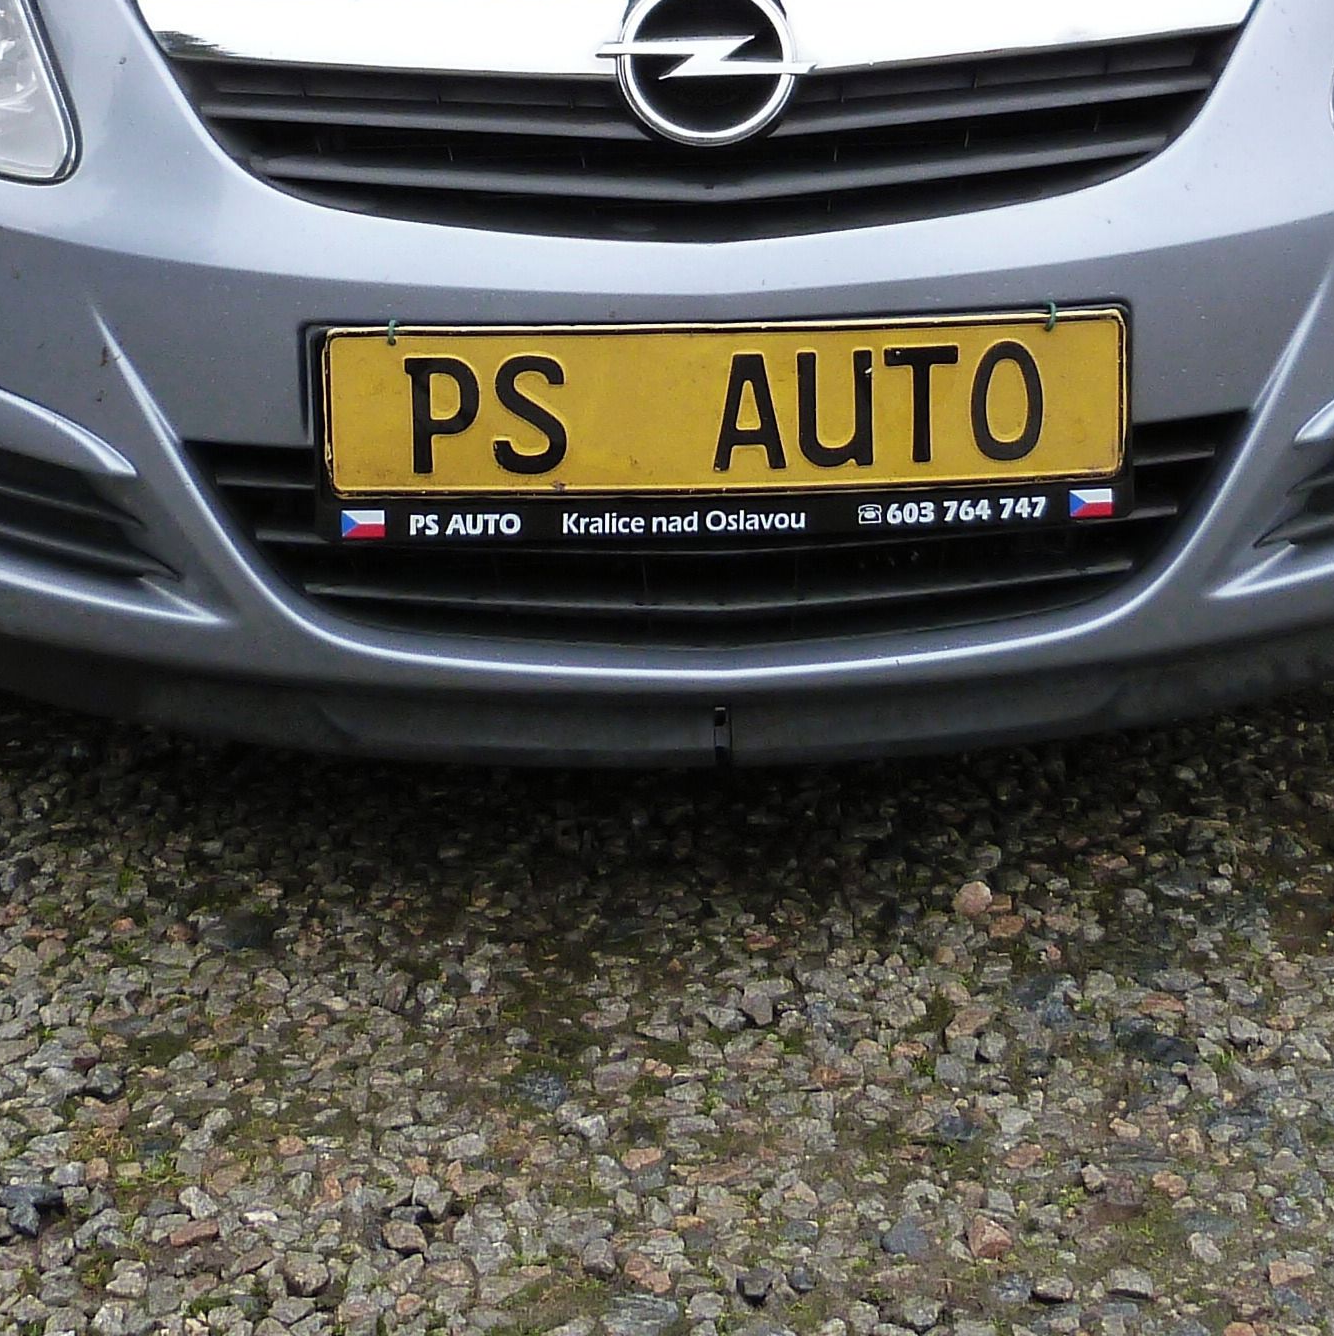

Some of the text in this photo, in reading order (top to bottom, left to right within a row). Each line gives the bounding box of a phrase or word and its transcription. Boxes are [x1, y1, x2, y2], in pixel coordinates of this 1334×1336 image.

[404, 339, 1045, 475] PS AUTO
[409, 496, 1047, 535] PS AUTO Kralice nad Oslavou 603 764 747
